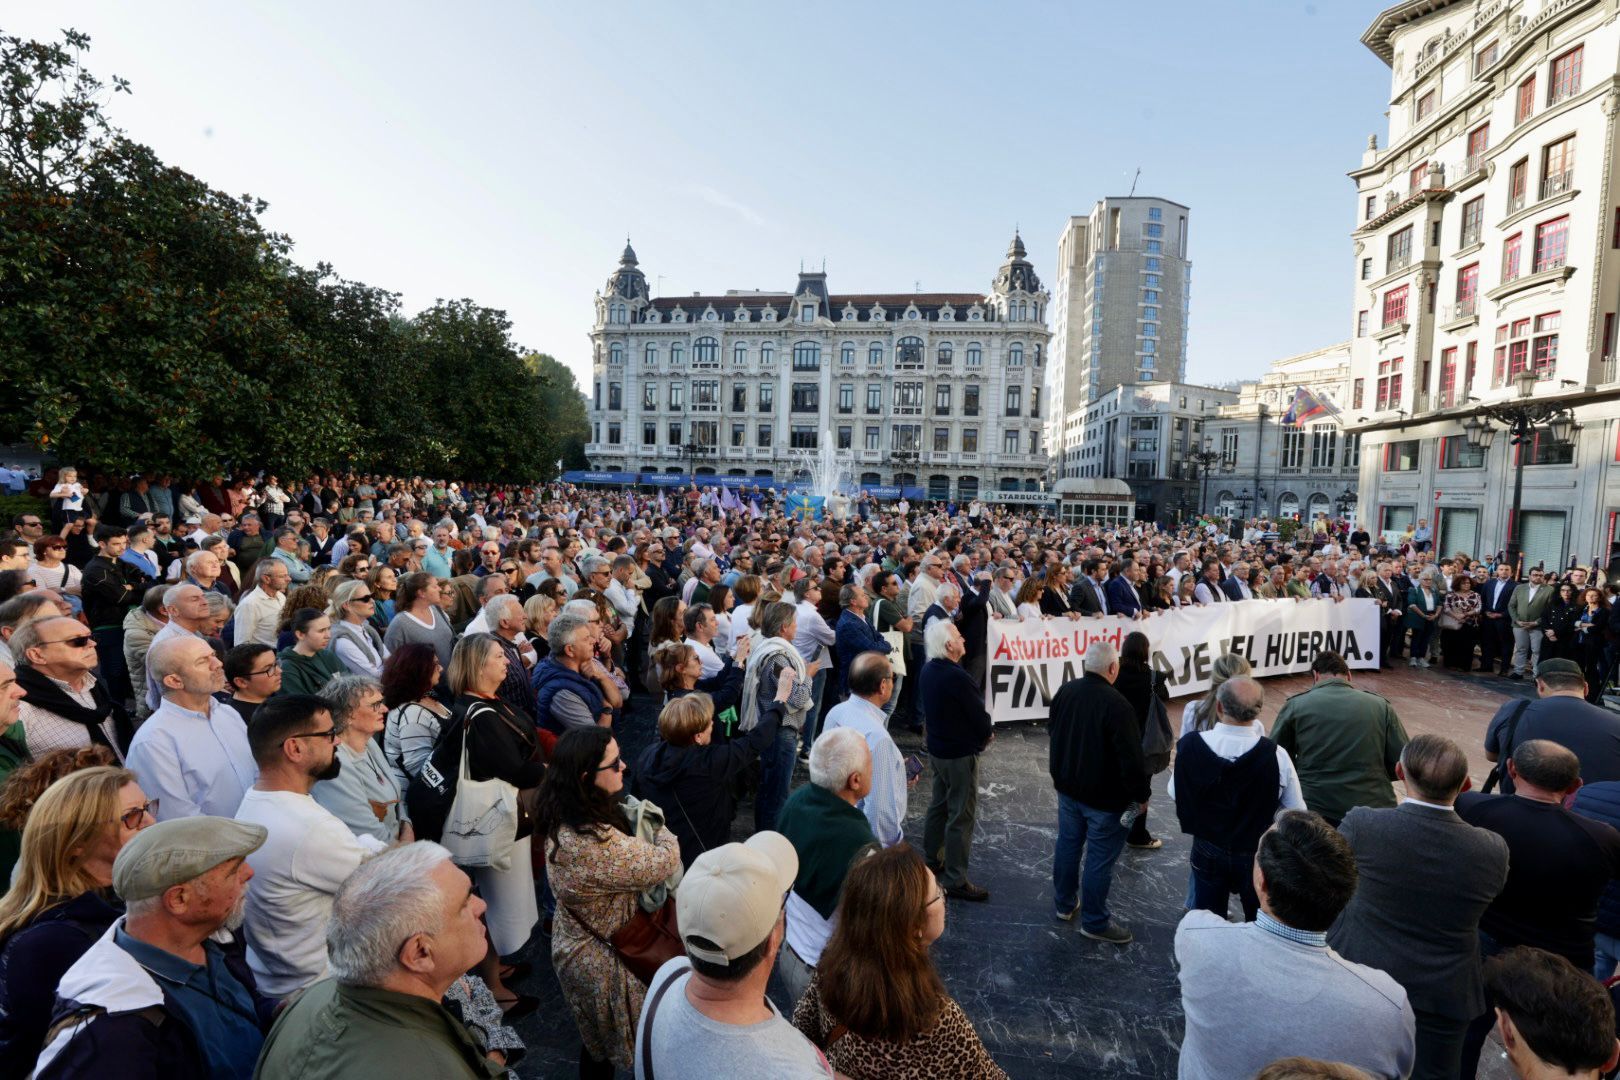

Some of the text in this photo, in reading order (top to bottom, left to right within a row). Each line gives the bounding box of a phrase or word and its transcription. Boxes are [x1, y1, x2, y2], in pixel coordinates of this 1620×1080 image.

[998, 493, 1048, 501] STARBUCKS
[993, 631, 1069, 660] Asturias
[991, 663, 1050, 708] FIN
[1152, 641, 1211, 687] AJE
